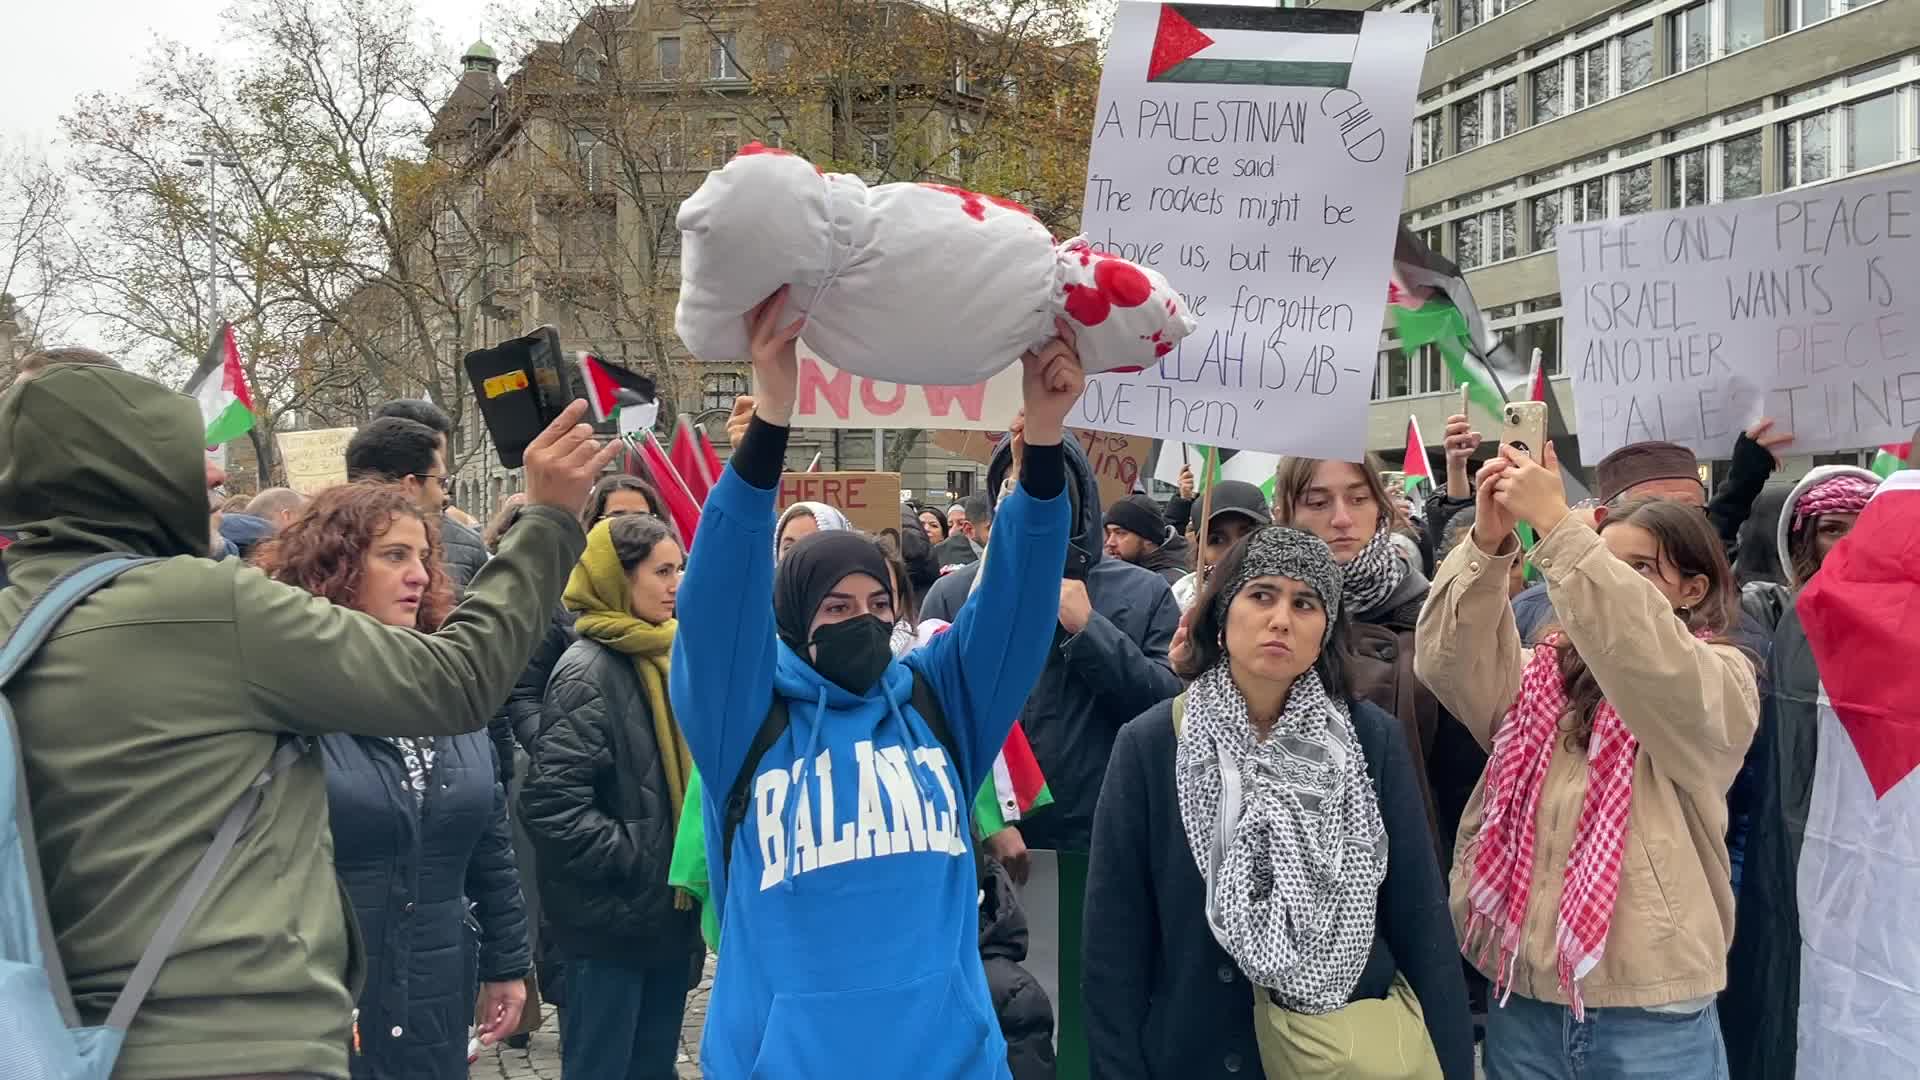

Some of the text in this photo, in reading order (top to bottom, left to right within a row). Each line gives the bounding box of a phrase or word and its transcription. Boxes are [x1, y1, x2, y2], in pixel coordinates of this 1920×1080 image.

[1098, 87, 1385, 163] A PALESTINIAN CHILD
[1167, 153, 1275, 178] once said
[1149, 186, 1224, 215] rockets
[1238, 193, 1300, 227] might
[1323, 194, 1355, 225] be
[1568, 190, 1912, 272] THE ONLY PEACE
[1180, 243, 1210, 272] us,
[1229, 246, 1270, 272] but
[1288, 246, 1337, 280] they
[1584, 255, 1894, 331] ISRAEL WANTS IS
[1230, 285, 1354, 349] forgotten
[1582, 311, 1908, 387] ANOTHER PIECE
[799, 358, 987, 421] NOW
[1140, 330, 1361, 396] LLAH IS AB-
[1082, 379, 1137, 426] OVE
[1599, 371, 1920, 448] PALETINE
[779, 479, 866, 508] HERE
